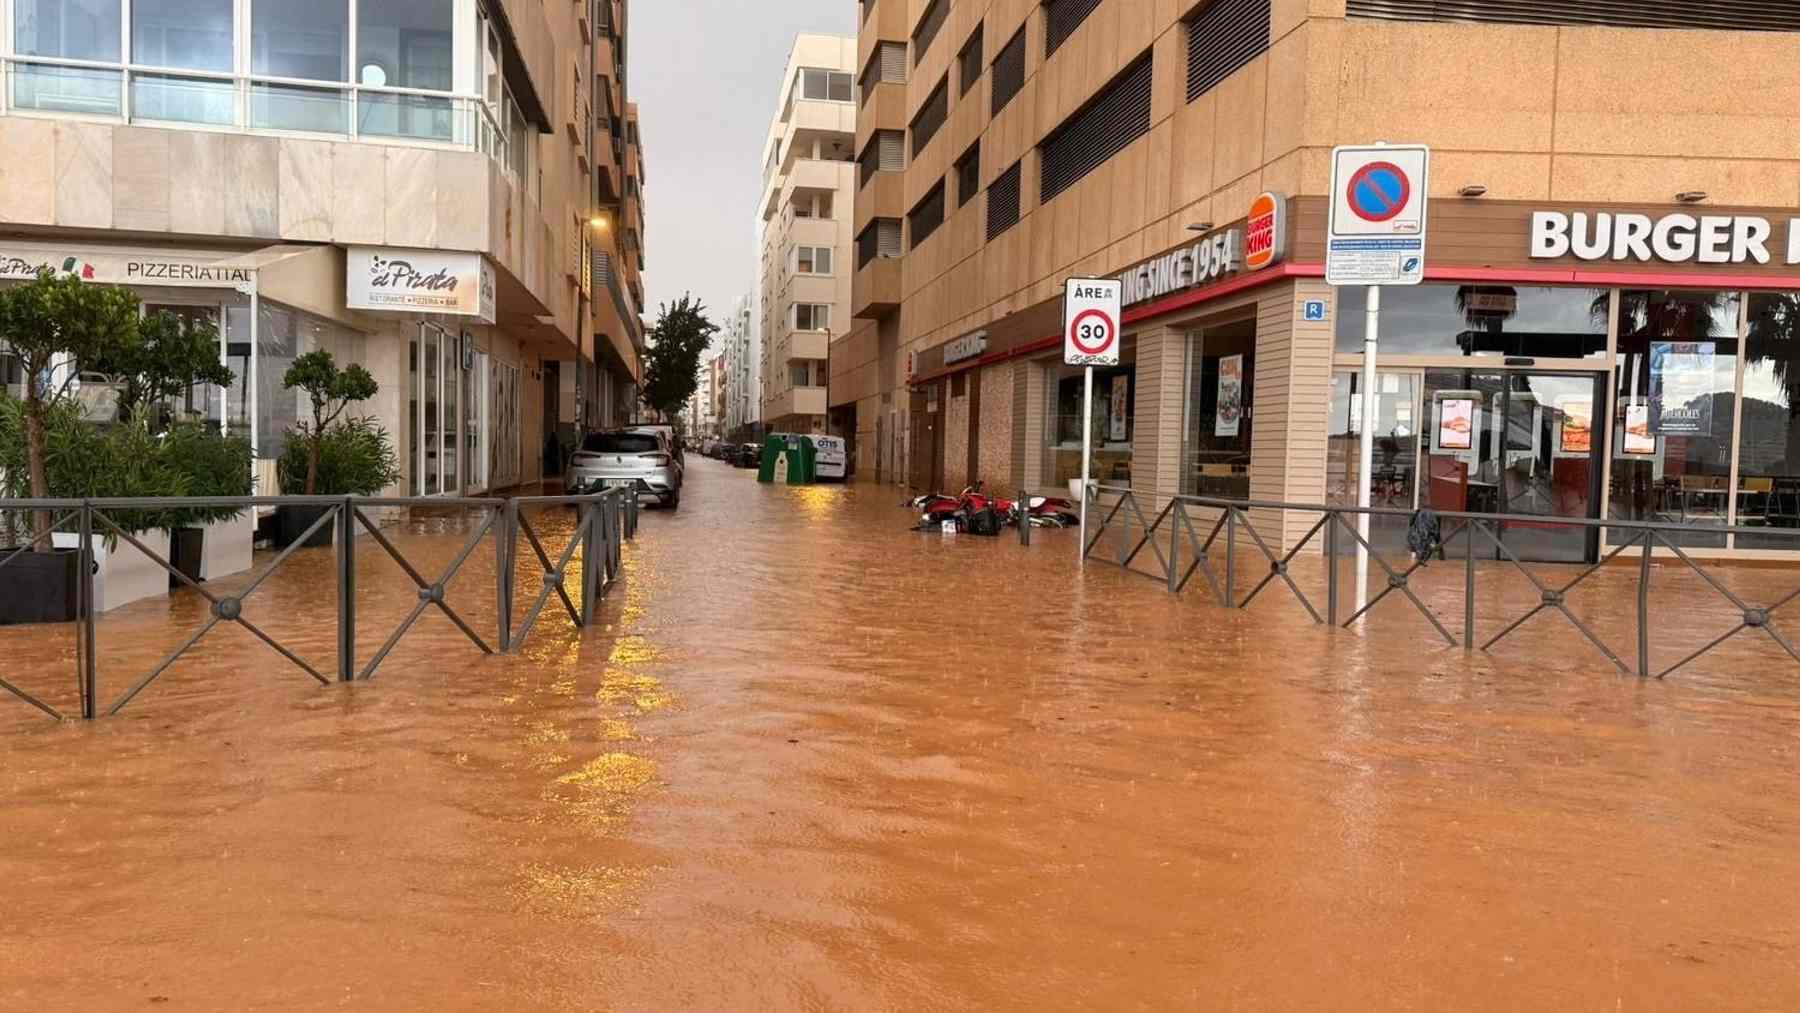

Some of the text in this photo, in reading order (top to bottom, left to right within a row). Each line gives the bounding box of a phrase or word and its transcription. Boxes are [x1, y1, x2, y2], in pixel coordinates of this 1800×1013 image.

[1247, 229, 1273, 256] KING
[1531, 211, 1771, 264] BURGER
[9, 258, 55, 278] Piraa
[128, 262, 212, 280] PIZZERIA
[388, 260, 458, 292] Pirata
[1121, 229, 1237, 306] ING SINCE 1954
[1081, 324, 1105, 339] 30
[817, 440, 838, 449] OTIS
